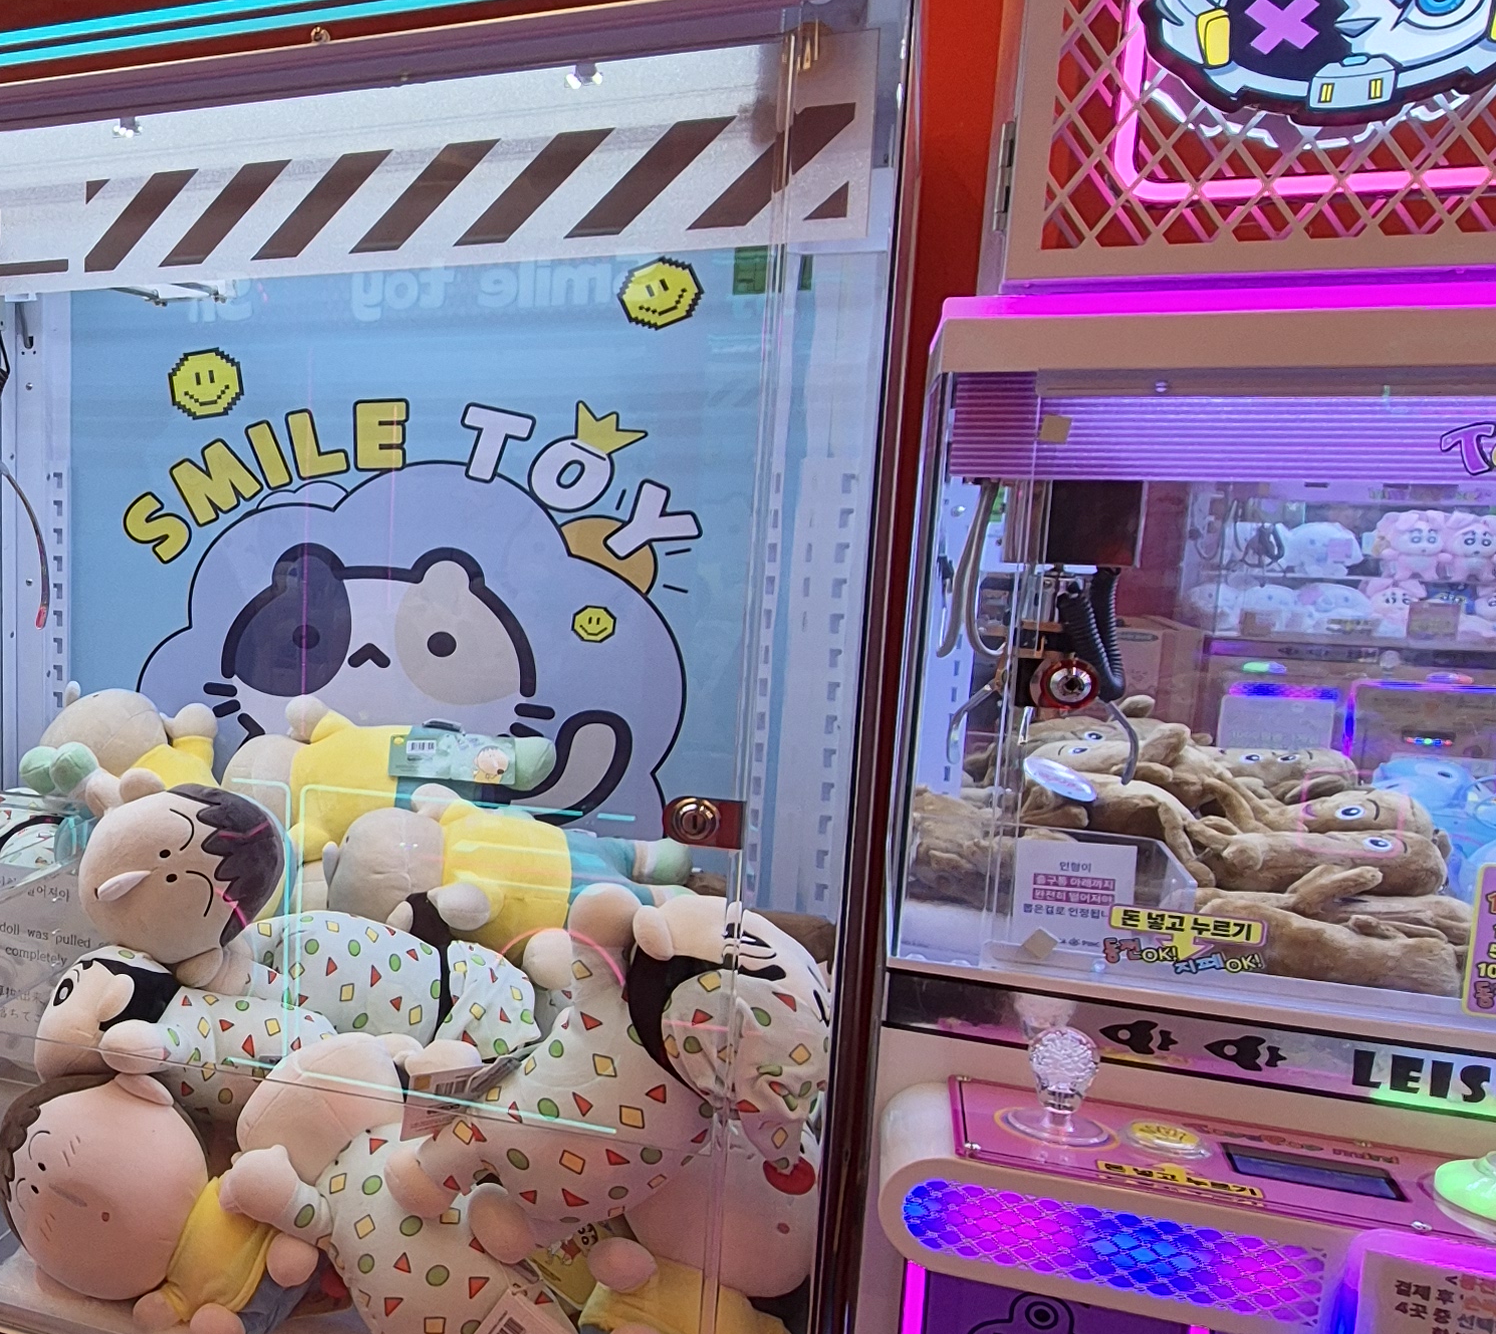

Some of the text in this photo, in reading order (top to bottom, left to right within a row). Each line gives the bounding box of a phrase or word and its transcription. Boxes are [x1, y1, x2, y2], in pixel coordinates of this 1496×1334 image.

[1440, 421, 1496, 476] T
[123, 399, 703, 563] SMILE TOY
[0, 922, 19, 935] doll
[27, 929, 48, 940] was
[56, 934, 91, 948] pulled
[1121, 909, 1253, 941] 돈 넣고 누르기
[5, 946, 67, 966] completely
[1352, 1049, 1492, 1104] LEIS
